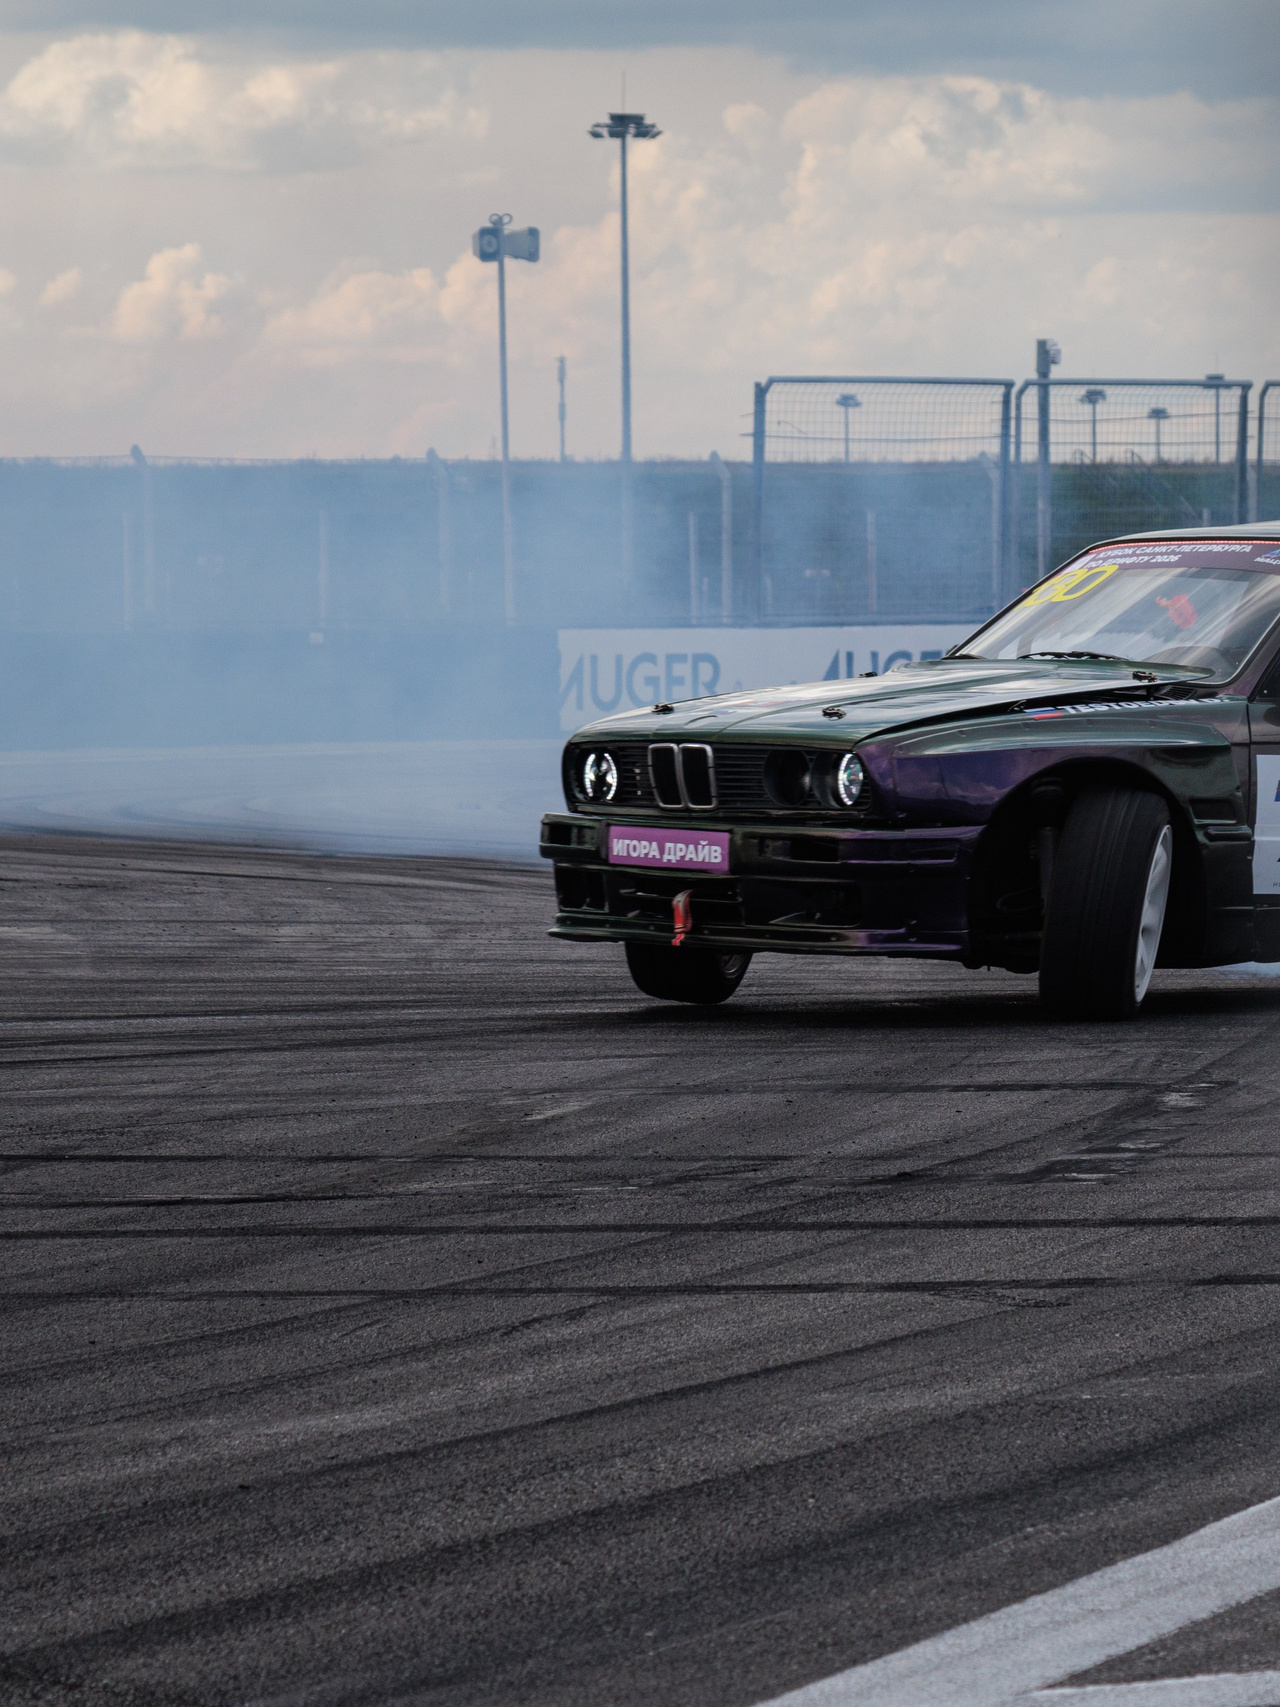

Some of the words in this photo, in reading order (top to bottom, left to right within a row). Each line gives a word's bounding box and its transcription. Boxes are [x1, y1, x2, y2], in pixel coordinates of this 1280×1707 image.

[1096, 547, 1138, 559] КУБОК
[1136, 544, 1253, 554] САНКТ-ПЕТЕРБУРГА
[1100, 556, 1152, 567] ДРИФТУ
[1149, 554, 1182, 563] 2026
[612, 838, 661, 859] ИГОРА
[662, 841, 723, 864] ДРАЙВ
